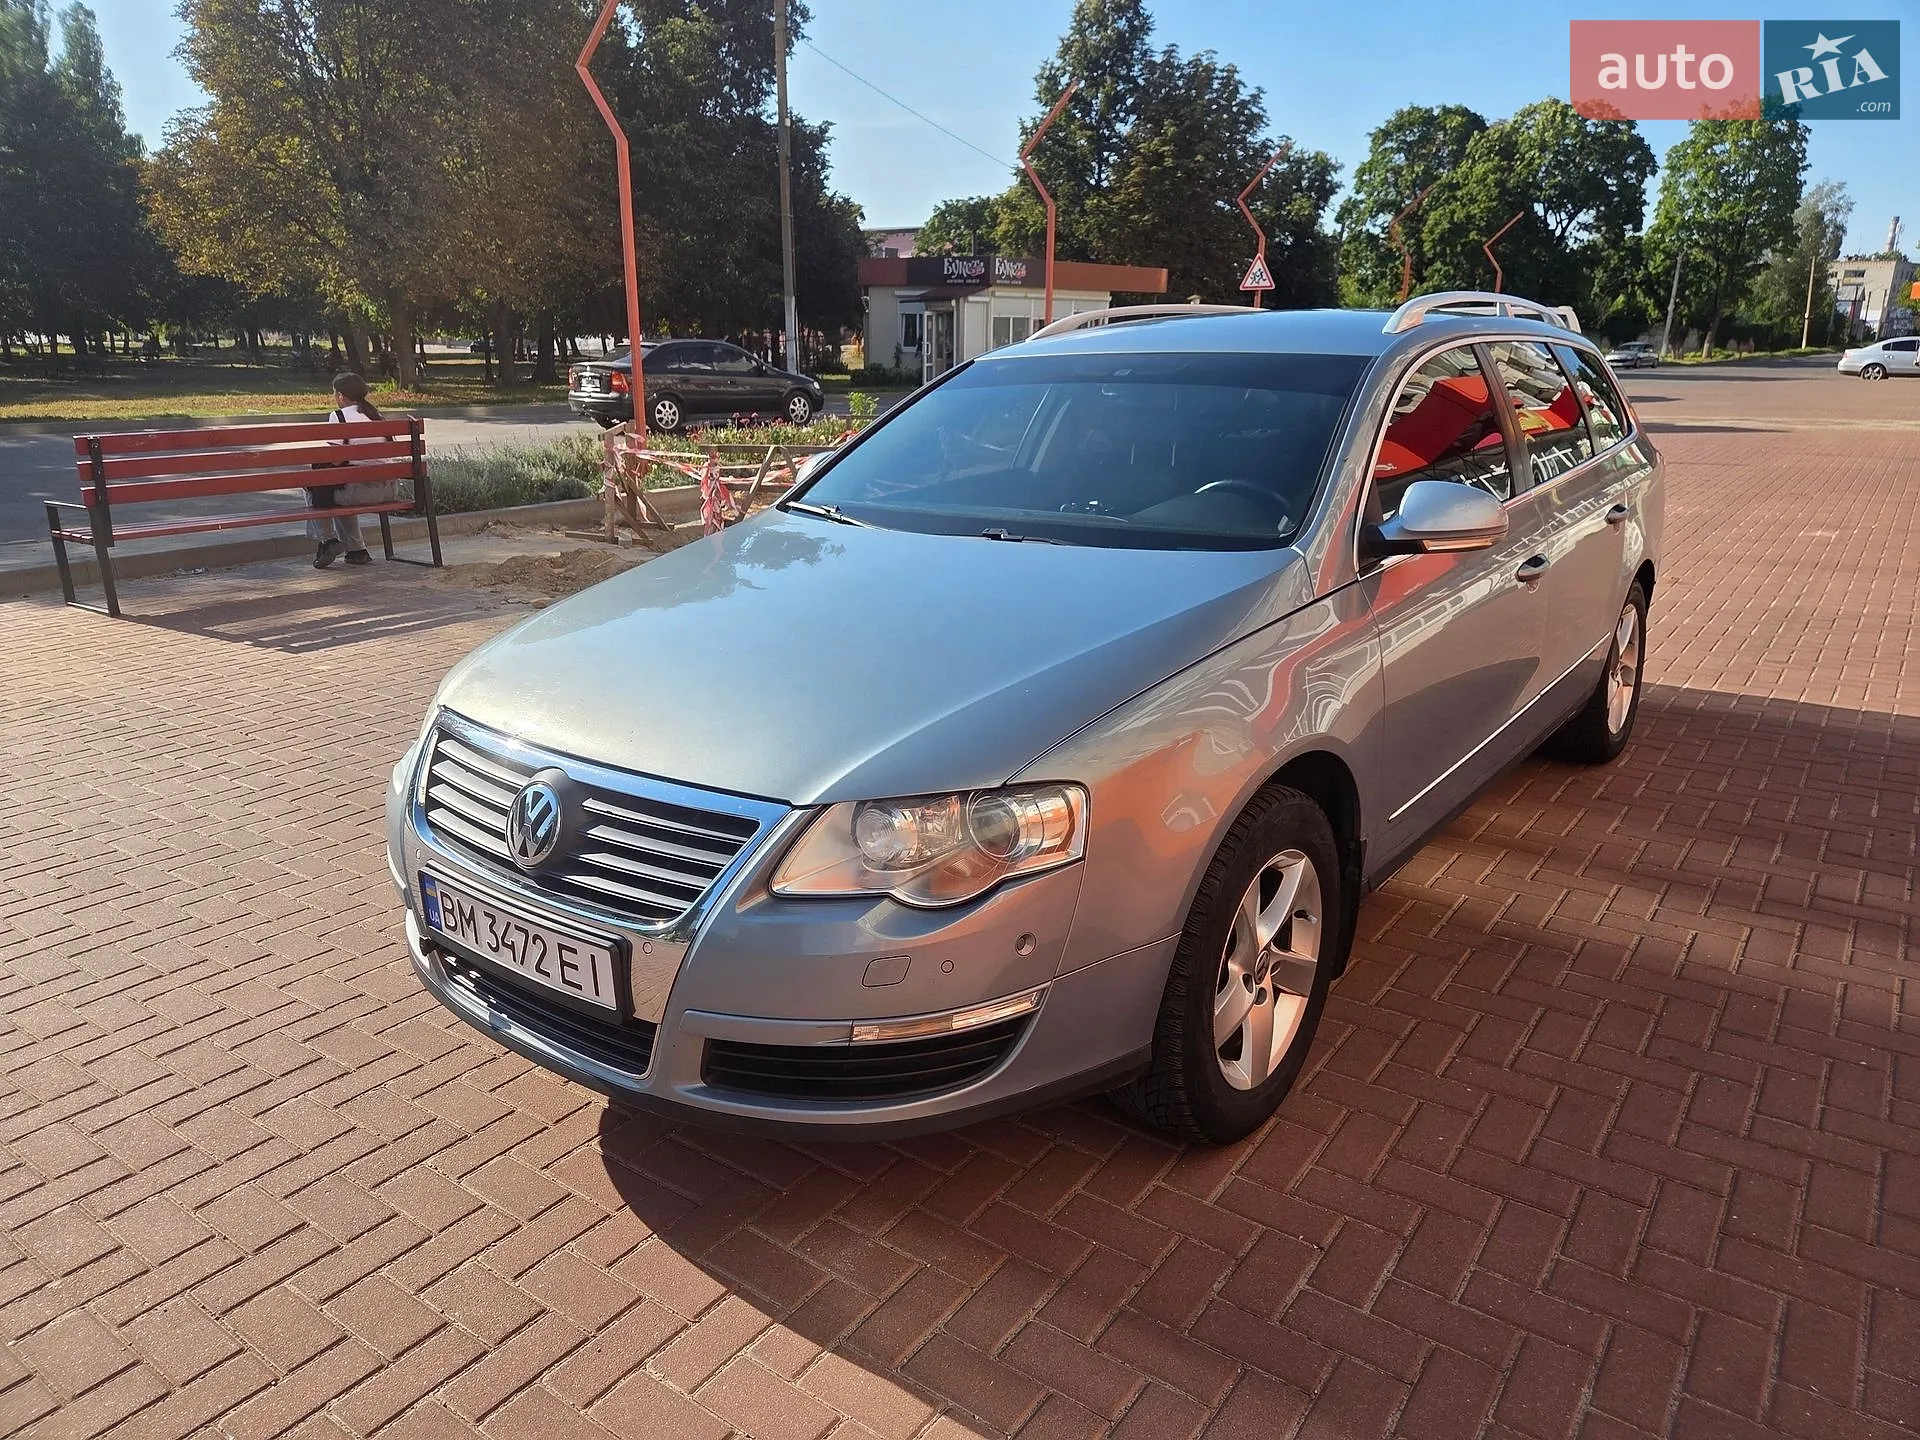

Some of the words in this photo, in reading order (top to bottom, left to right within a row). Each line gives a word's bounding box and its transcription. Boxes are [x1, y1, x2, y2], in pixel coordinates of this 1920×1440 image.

[428, 910, 441, 926] UA
[440, 890, 479, 945] BM
[483, 910, 551, 978] 3472
[557, 942, 600, 997] EI
